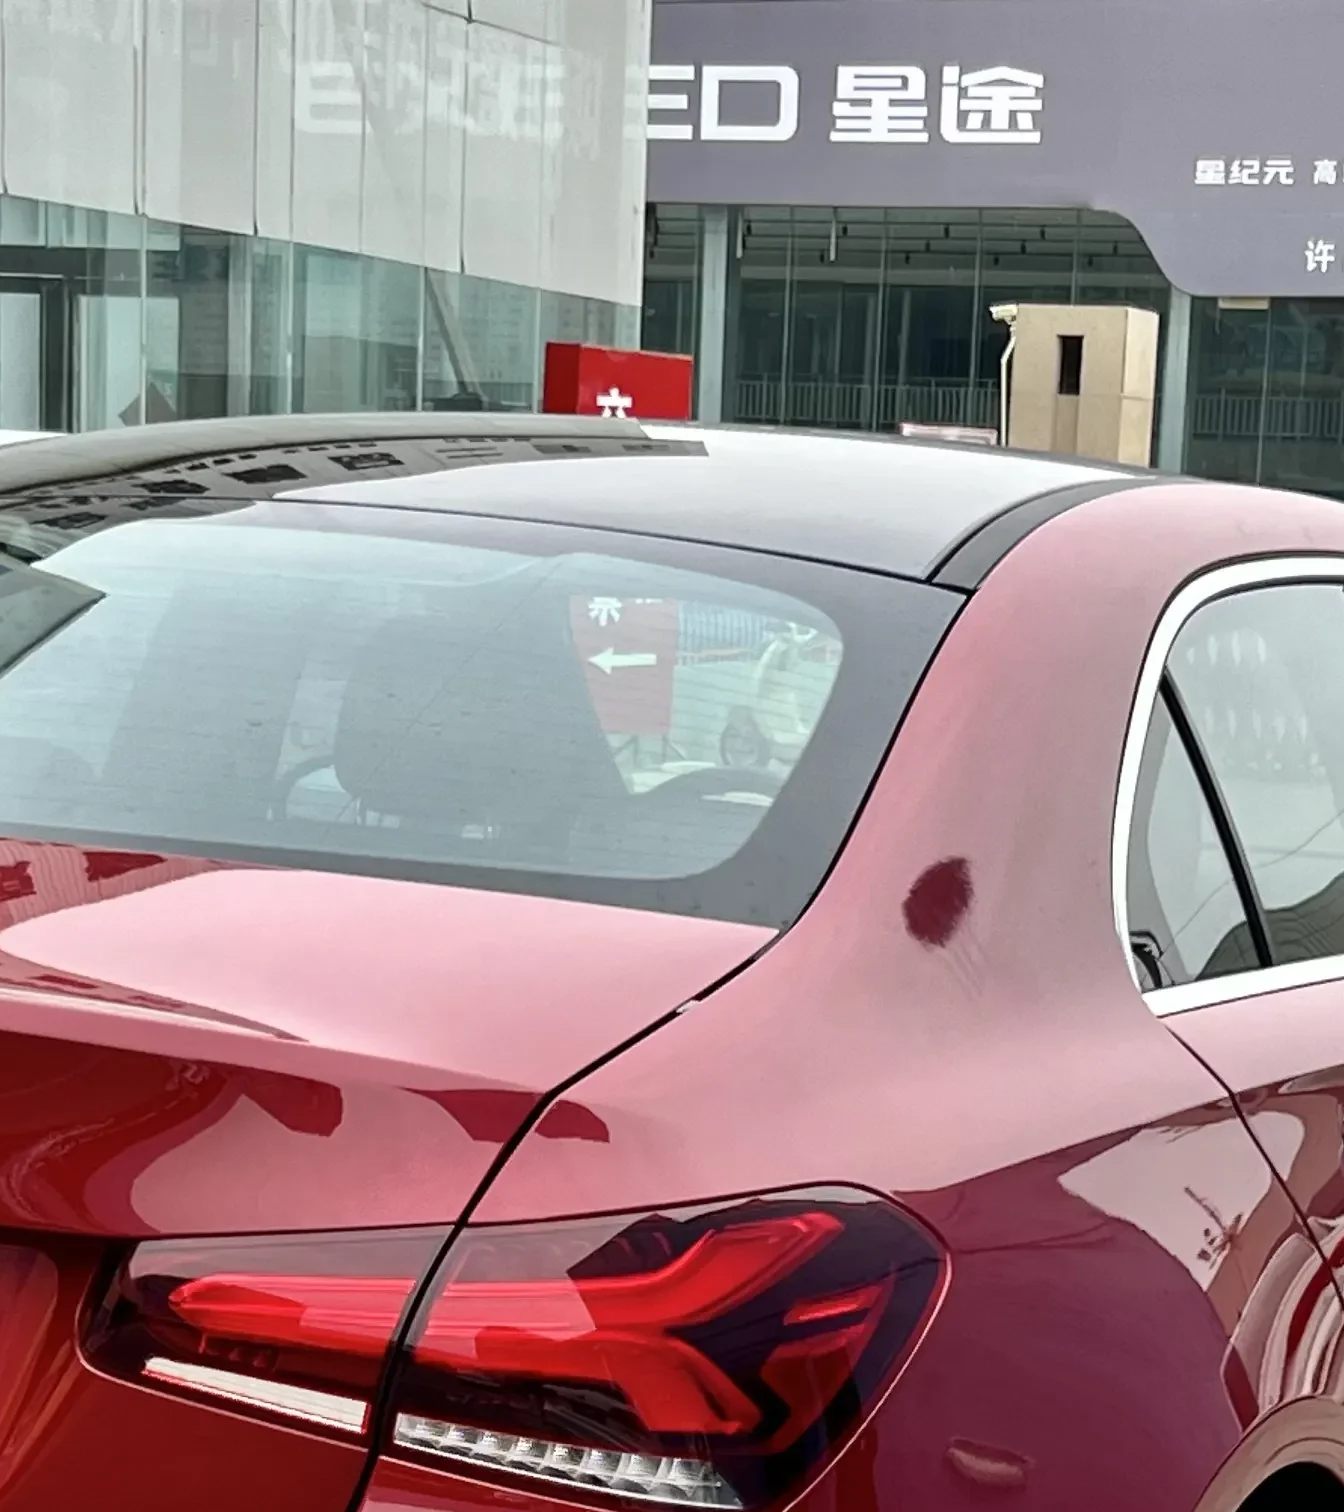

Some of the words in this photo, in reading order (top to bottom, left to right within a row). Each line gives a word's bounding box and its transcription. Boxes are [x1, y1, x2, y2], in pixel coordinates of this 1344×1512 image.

[830, 65, 1044, 143] 星途
[1195, 157, 1294, 185] 星纪元
